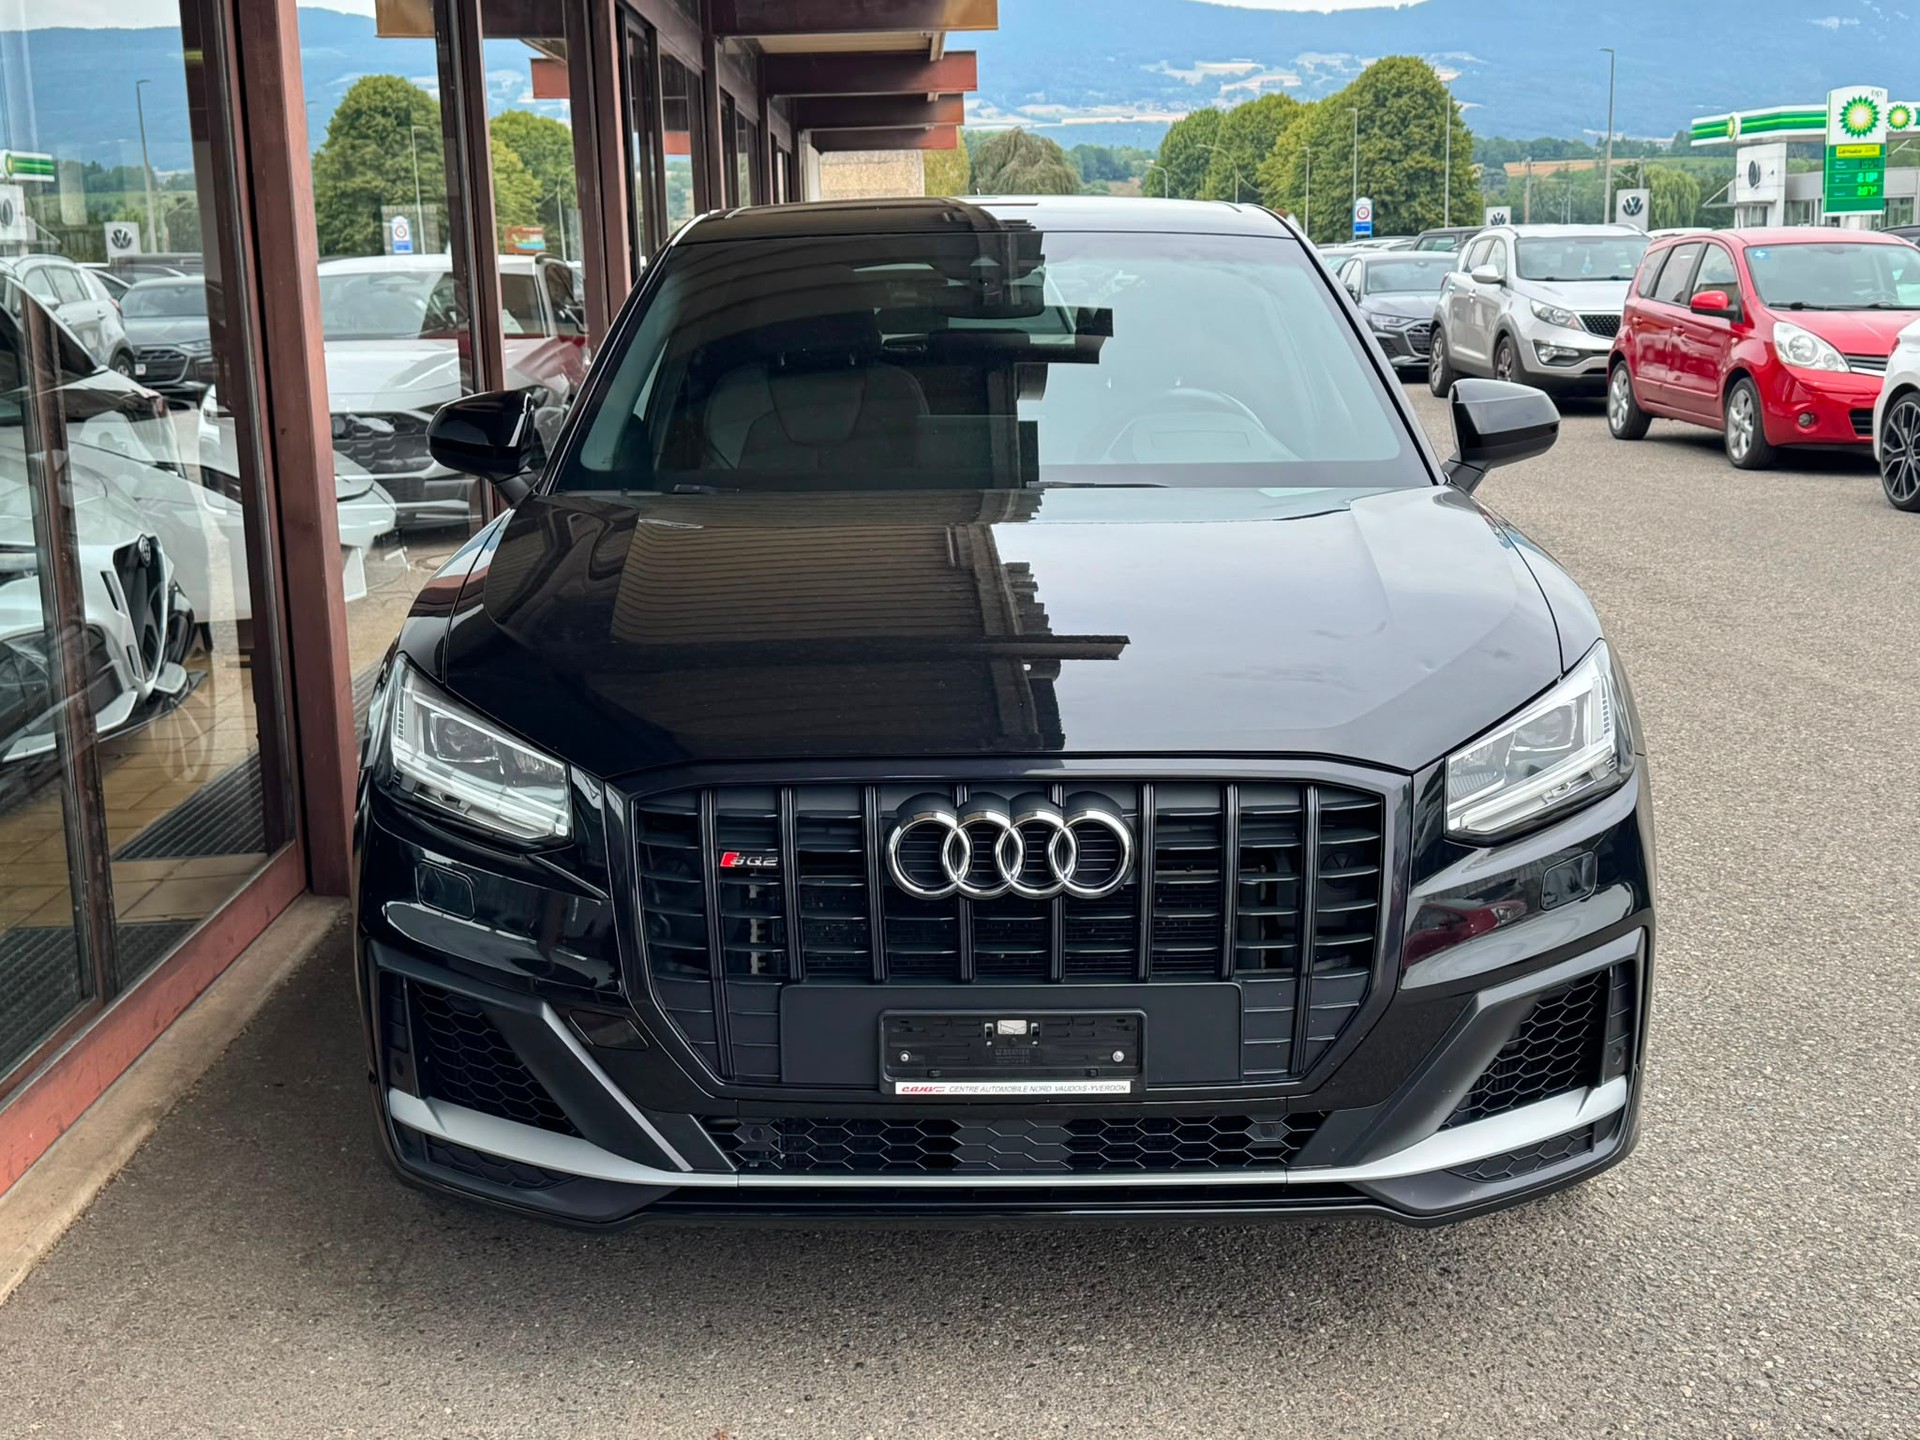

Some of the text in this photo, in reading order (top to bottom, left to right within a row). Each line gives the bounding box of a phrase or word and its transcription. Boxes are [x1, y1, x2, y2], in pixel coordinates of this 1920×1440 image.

[729, 855, 779, 867] SQ2
[948, 1085, 980, 1094] CENTRE
[979, 1085, 1030, 1094] AUTOMOBILE
[1029, 1085, 1053, 1093] NORD
